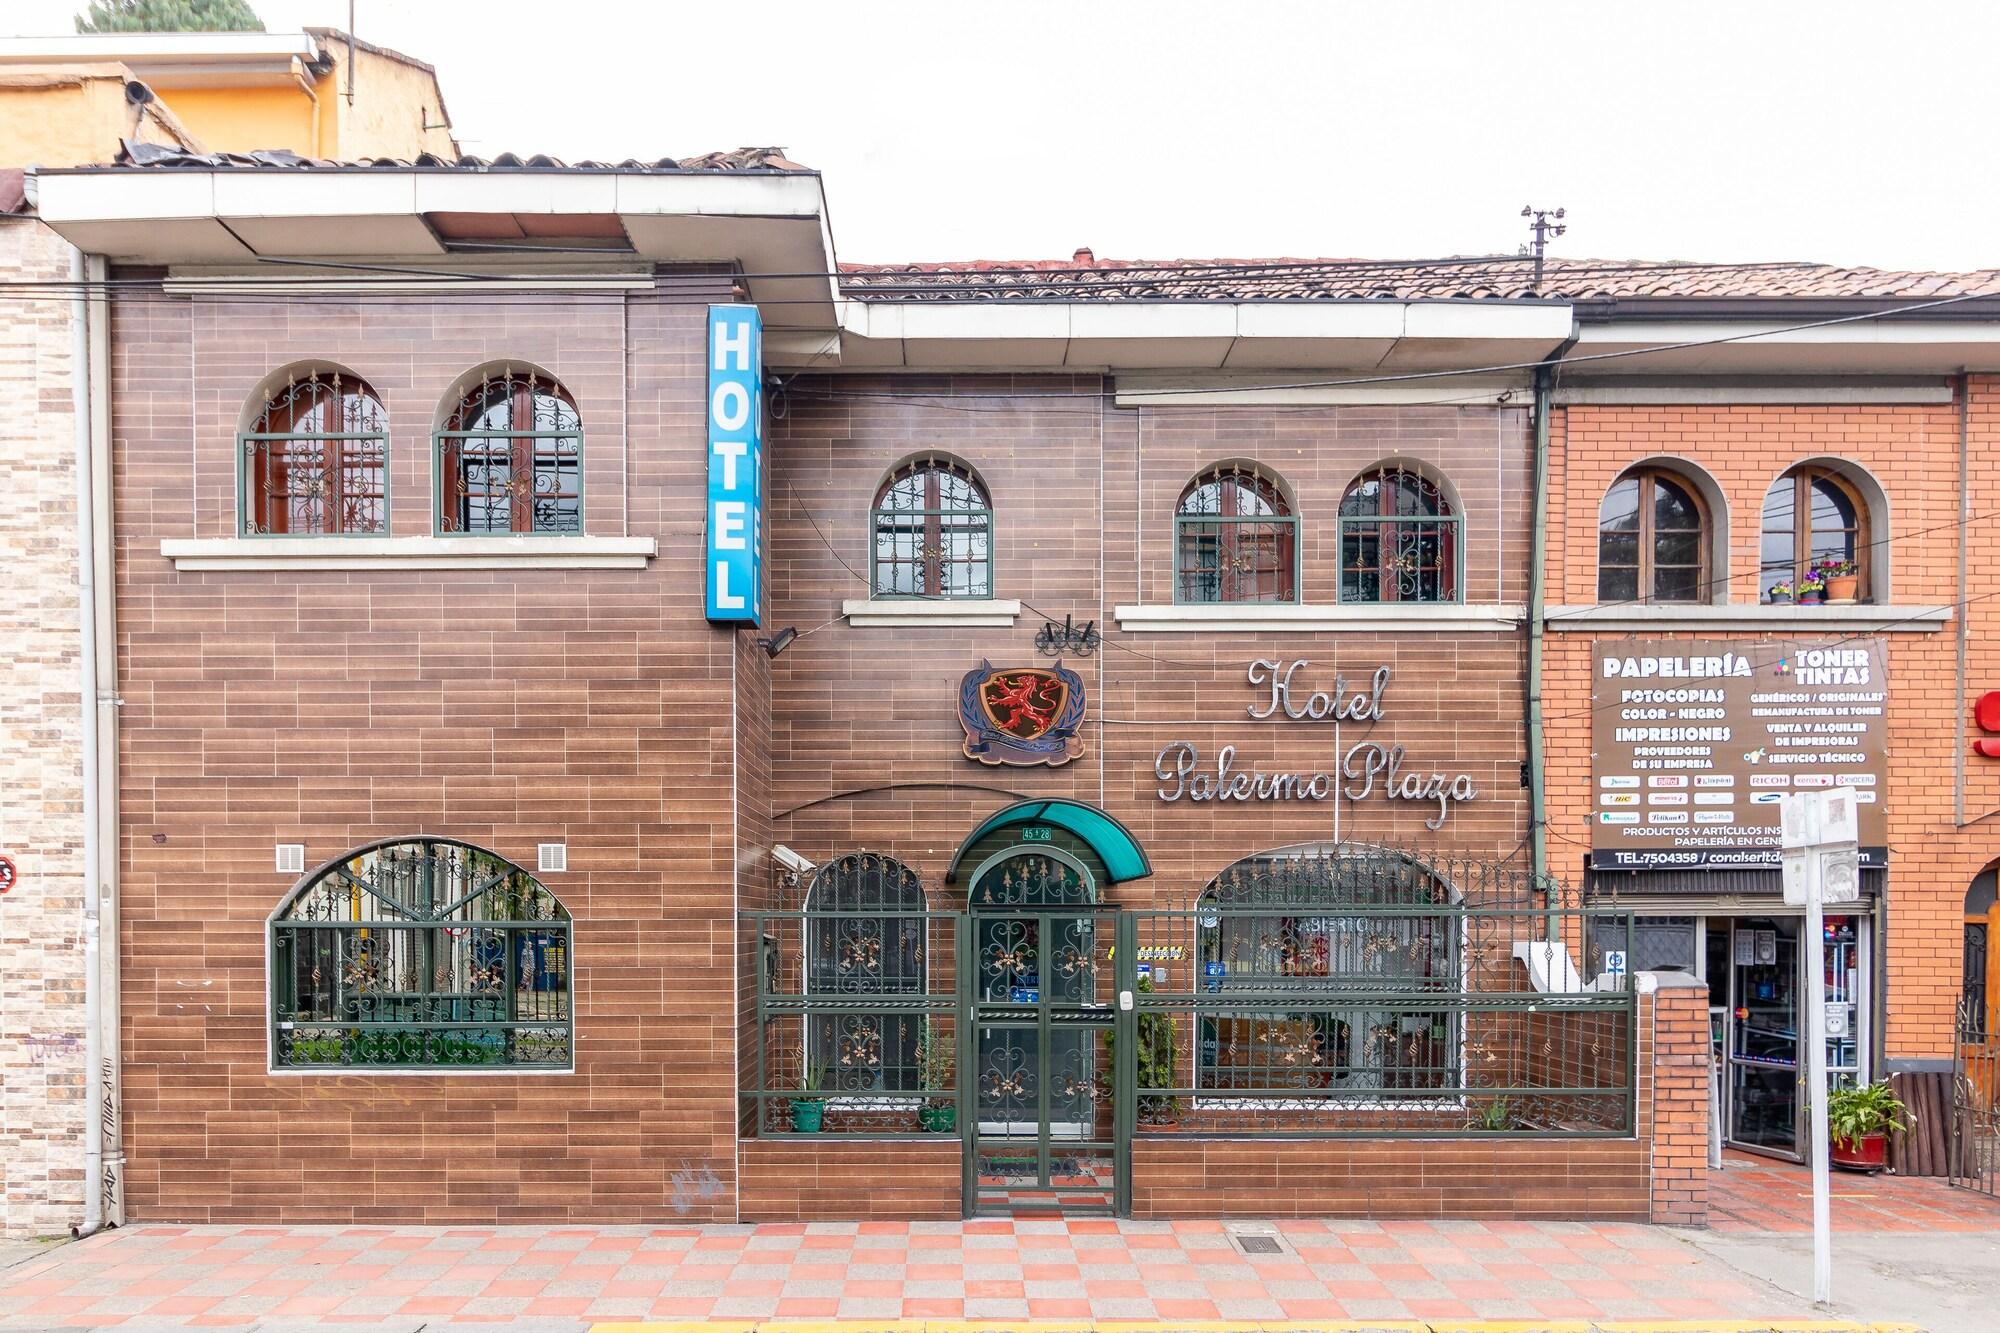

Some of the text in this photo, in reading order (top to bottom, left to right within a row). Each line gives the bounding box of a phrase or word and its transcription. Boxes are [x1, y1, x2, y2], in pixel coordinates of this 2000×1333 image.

[713, 322, 750, 609] HOTEL
[753, 328, 762, 616] HOTEL
[1794, 649, 1870, 667] TONER
[1603, 652, 1753, 678] PAPELERÍA
[1794, 667, 1870, 685] TINTAS
[1246, 659, 1390, 721] Hotel
[1621, 689, 1725, 703] FOTOCOPIAS
[1751, 692, 1810, 703] GENÉRICOS
[1818, 692, 1883, 702] ORIGINALES
[1621, 708, 1667, 720] COLOR
[1678, 707, 1726, 719] NEGRO
[1752, 707, 1882, 716] REMANUFACTURA DE TONER
[1766, 723, 1867, 733] VENTA Y ALQUILER
[1615, 727, 1731, 742] IMPRESIONES
[1775, 736, 1859, 746] DE IMPRESORAS
[1634, 747, 1711, 756] PROVEEDORES
[1768, 753, 1866, 763] SERVICIO TÉCNICO
[1632, 760, 1713, 769] DE SU EMPRESA
[1155, 741, 1330, 801] Palermo
[1343, 742, 1478, 830] Plaza
[1024, 829, 1033, 838] 45
[1040, 829, 1050, 838] 28
[1623, 826, 1782, 836] PRODUCTOS Y ARTÍCULOS INS
[1674, 836, 1782, 846] PAPELERÍA EN GENE
[1614, 852, 1698, 863] TEL:7504358
